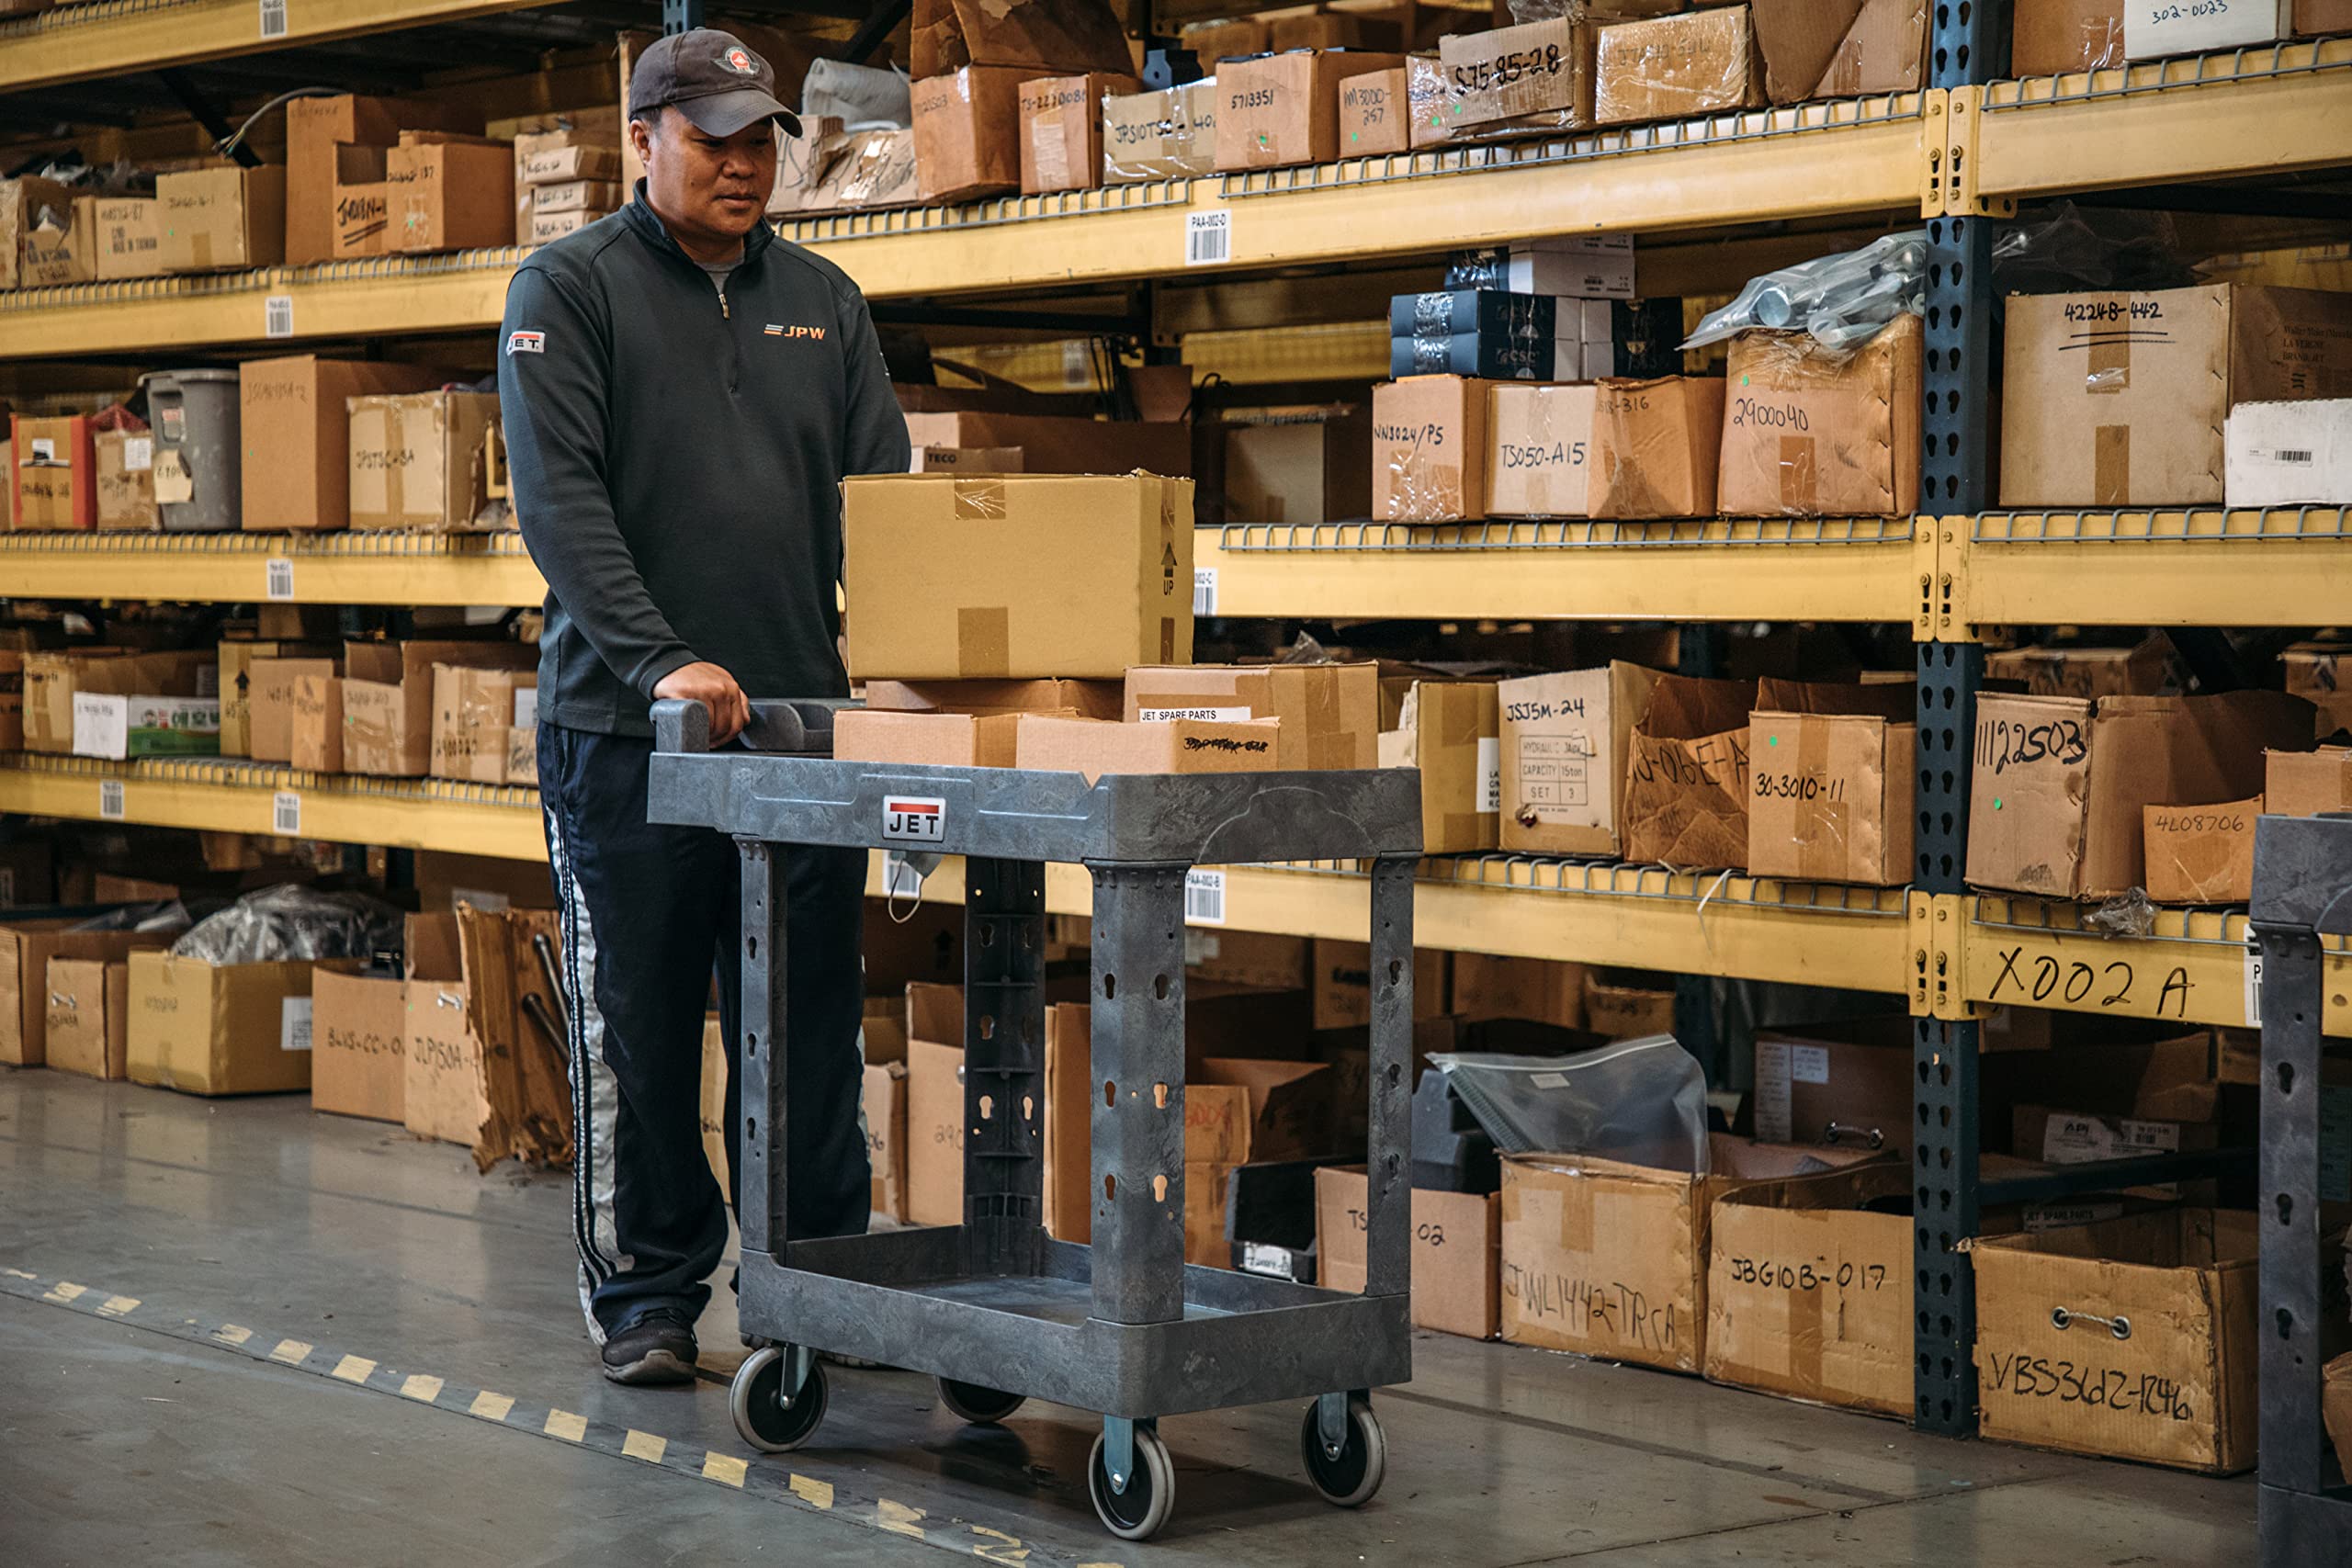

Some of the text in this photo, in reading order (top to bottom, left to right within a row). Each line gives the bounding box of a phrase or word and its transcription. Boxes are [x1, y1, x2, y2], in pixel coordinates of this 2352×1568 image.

[2152, 0, 2228, 24] 302-0023
[1231, 90, 1273, 109] 5713351
[1192, 213, 1227, 228] PAA-002-D
[2064, 301, 2163, 322] 42248-442
[784, 325, 826, 341] JPW
[1733, 397, 1810, 433] 2900040
[927, 452, 956, 464] TECO
[1163, 580, 1174, 596] UP
[1142, 710, 1217, 721] JET SPARE PARTS
[1522, 764, 1557, 777] CAPACITY
[1531, 786, 1550, 799] SET
[1755, 773, 1845, 802] 30-3010-11
[889, 814, 939, 834] JET
[2155, 815, 2245, 832] 4L08706
[1988, 946, 2195, 1018] X002 A
